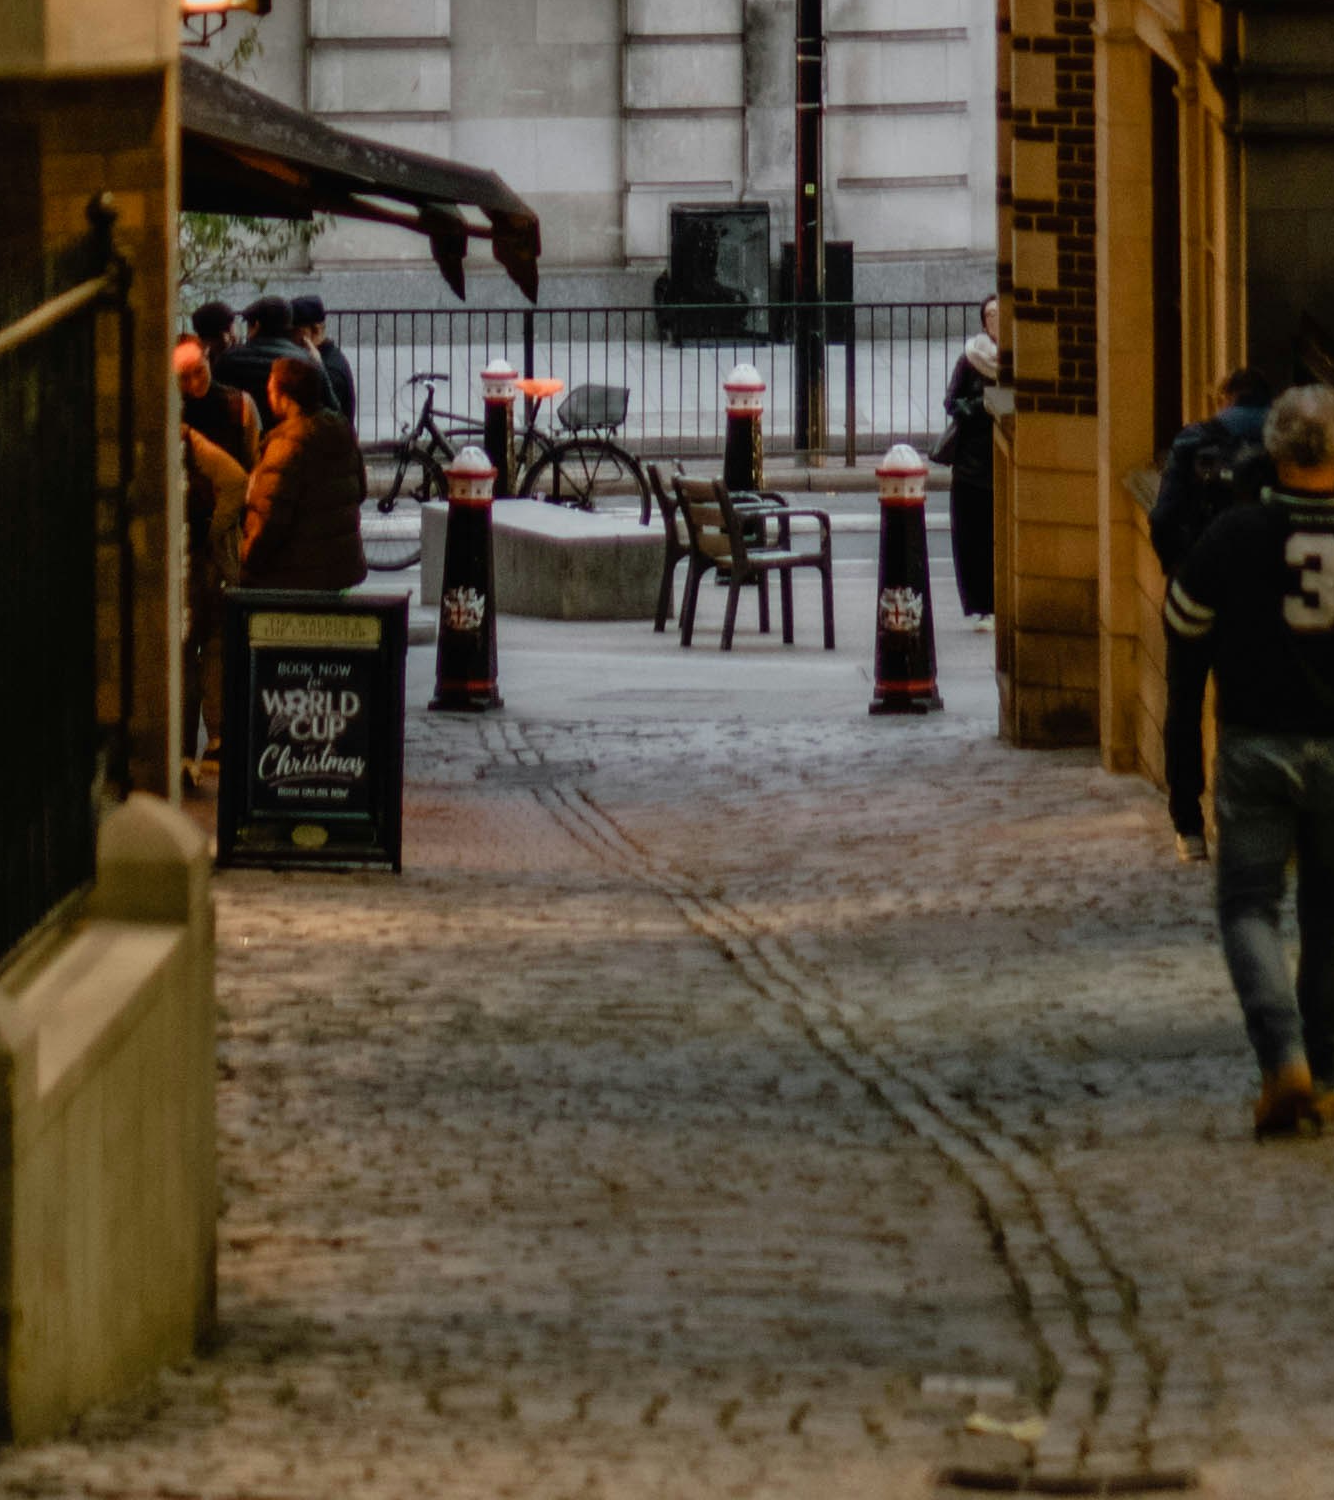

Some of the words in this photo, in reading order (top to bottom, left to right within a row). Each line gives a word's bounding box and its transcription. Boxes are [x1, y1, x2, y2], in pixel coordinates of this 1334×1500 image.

[277, 662, 313, 677] BOOK
[318, 664, 351, 677] NOW
[262, 689, 361, 717] WORLD
[289, 715, 347, 741] CUP
[258, 743, 366, 780] Christmas
